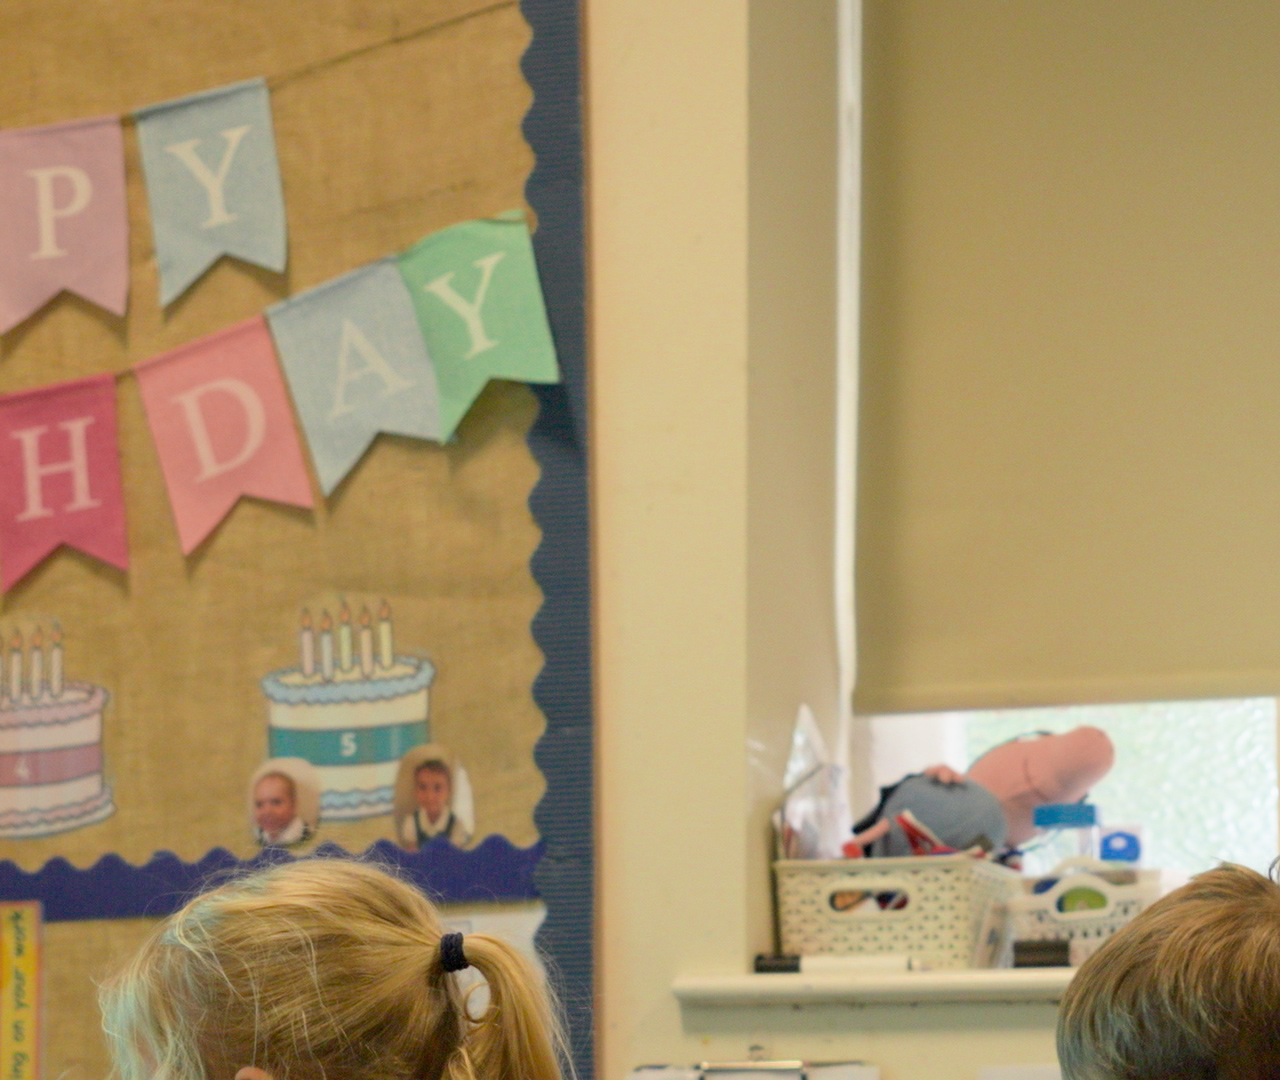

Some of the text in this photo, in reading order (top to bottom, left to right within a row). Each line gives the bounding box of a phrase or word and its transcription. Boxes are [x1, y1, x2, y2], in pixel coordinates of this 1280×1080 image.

[341, 733, 357, 757] 5
[8, 910, 25, 957] work
[12, 967, 30, 1010] your
[11, 1020, 25, 1043] on
